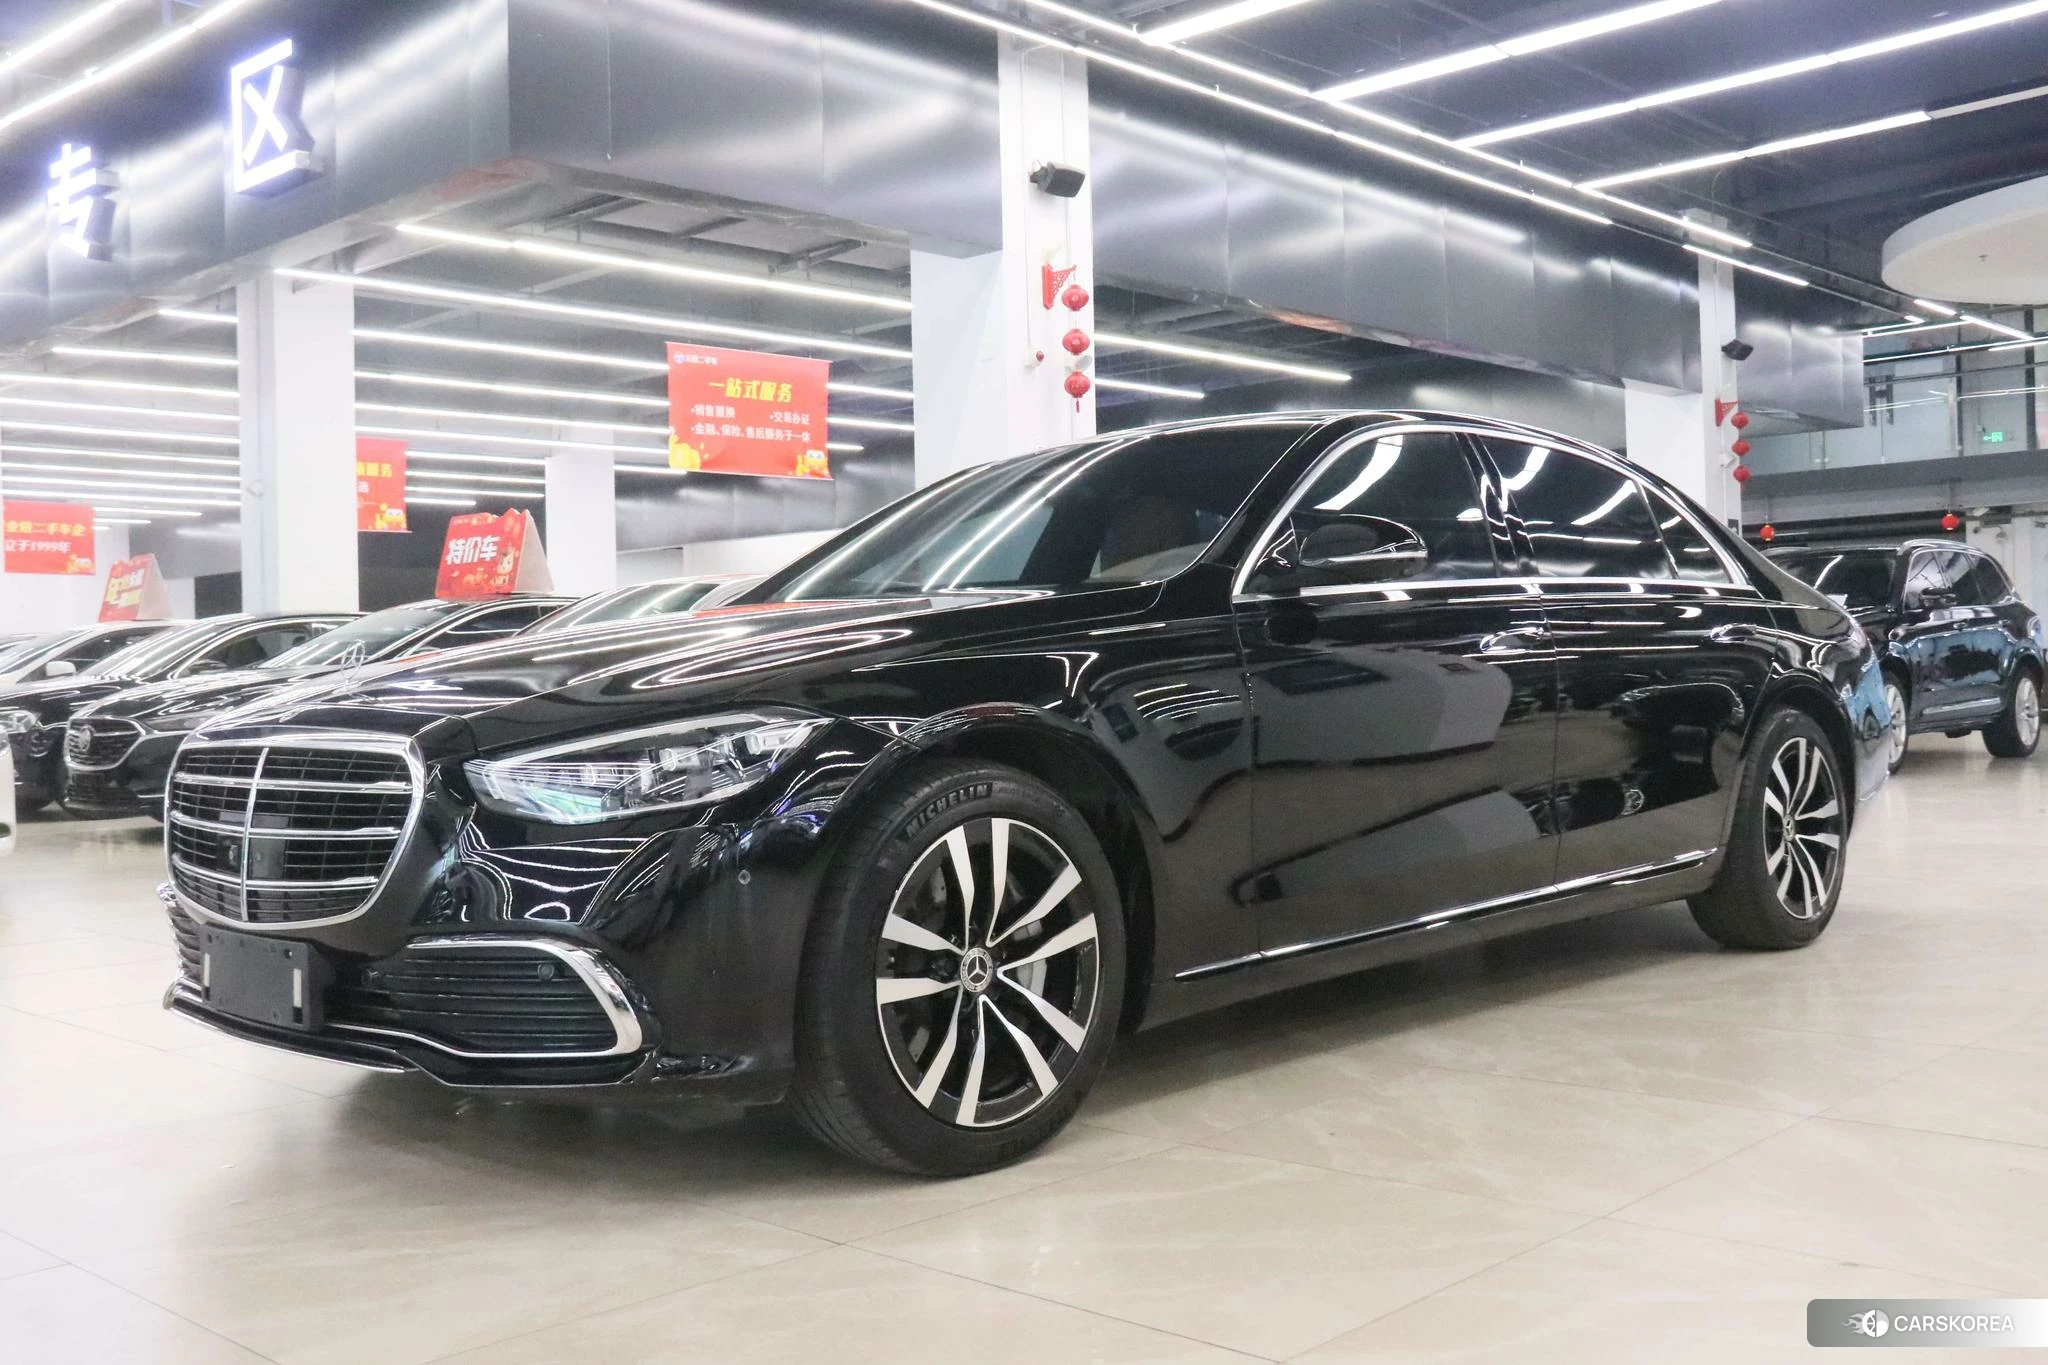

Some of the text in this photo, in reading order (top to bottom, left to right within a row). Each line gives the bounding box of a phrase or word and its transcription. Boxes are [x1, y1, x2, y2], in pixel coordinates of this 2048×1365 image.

[47, 38, 293, 260] 专区
[708, 377, 793, 403] 一站式服务
[694, 404, 736, 418] 销售置换
[773, 411, 811, 425] 交易办证
[445, 535, 500, 566] 特价车
[905, 784, 988, 839] MICHELIN
